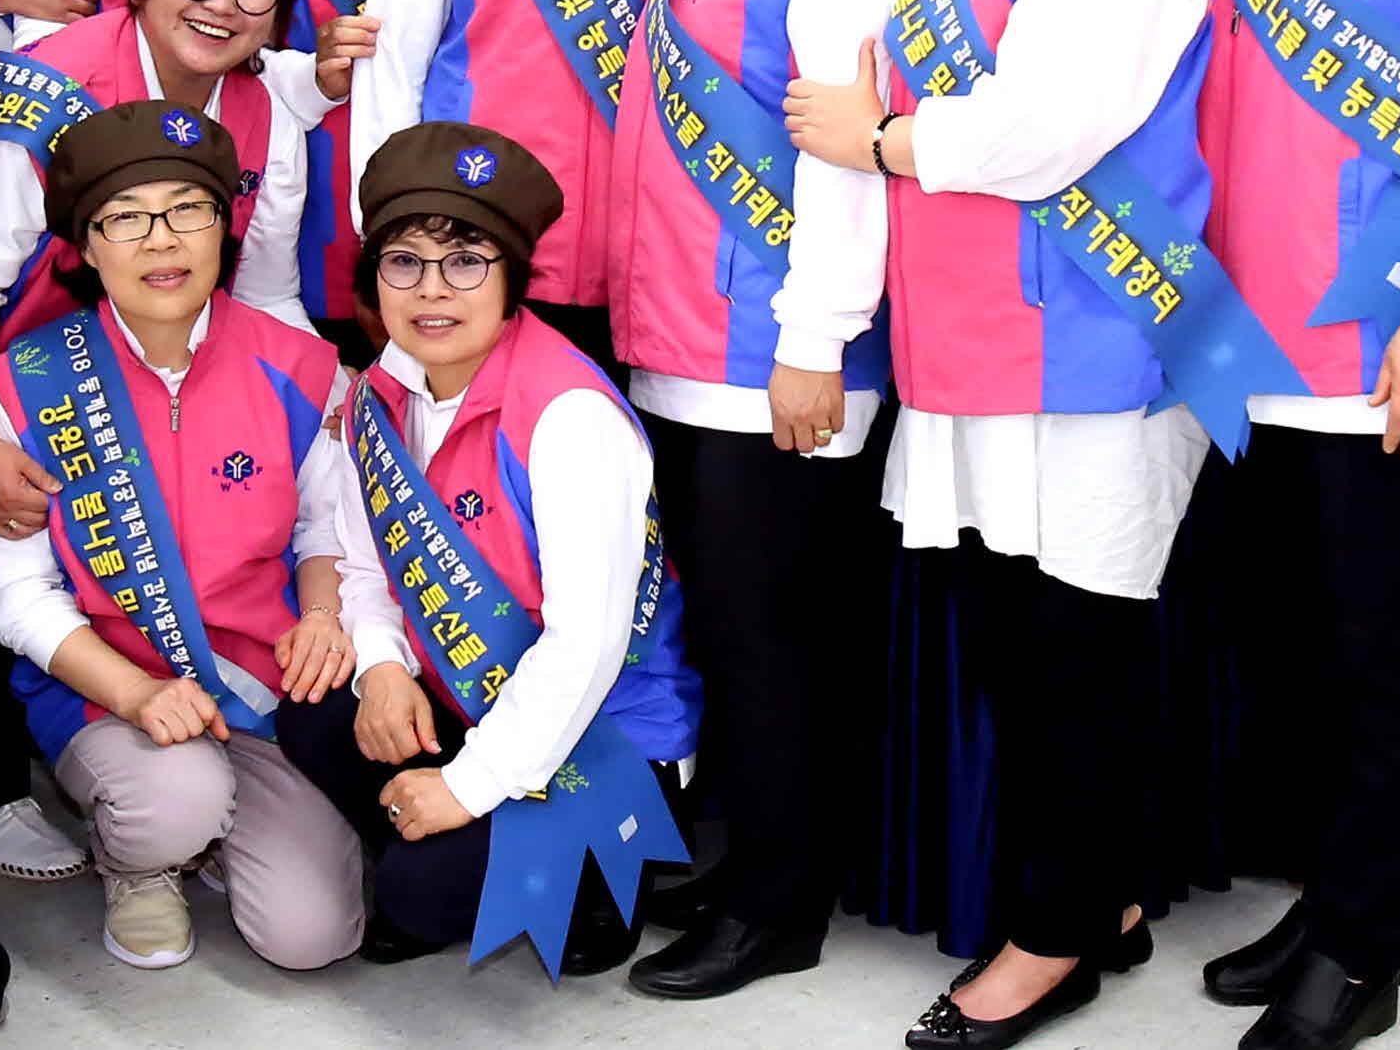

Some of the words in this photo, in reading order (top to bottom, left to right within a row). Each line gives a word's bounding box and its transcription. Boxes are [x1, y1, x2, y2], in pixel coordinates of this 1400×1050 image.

[1301, 49, 1337, 93] 및
[1057, 184, 1182, 324] 직거래장터
[63, 323, 92, 373] 2018
[77, 375, 124, 464] 동계올림픽
[38, 394, 97, 483] 강원도
[71, 491, 127, 578] 봄나물
[108, 467, 160, 575] 성공개최기념
[383, 520, 412, 557] 및
[399, 555, 488, 672] 농특산물
[407, 501, 483, 601] 감사할인행사
